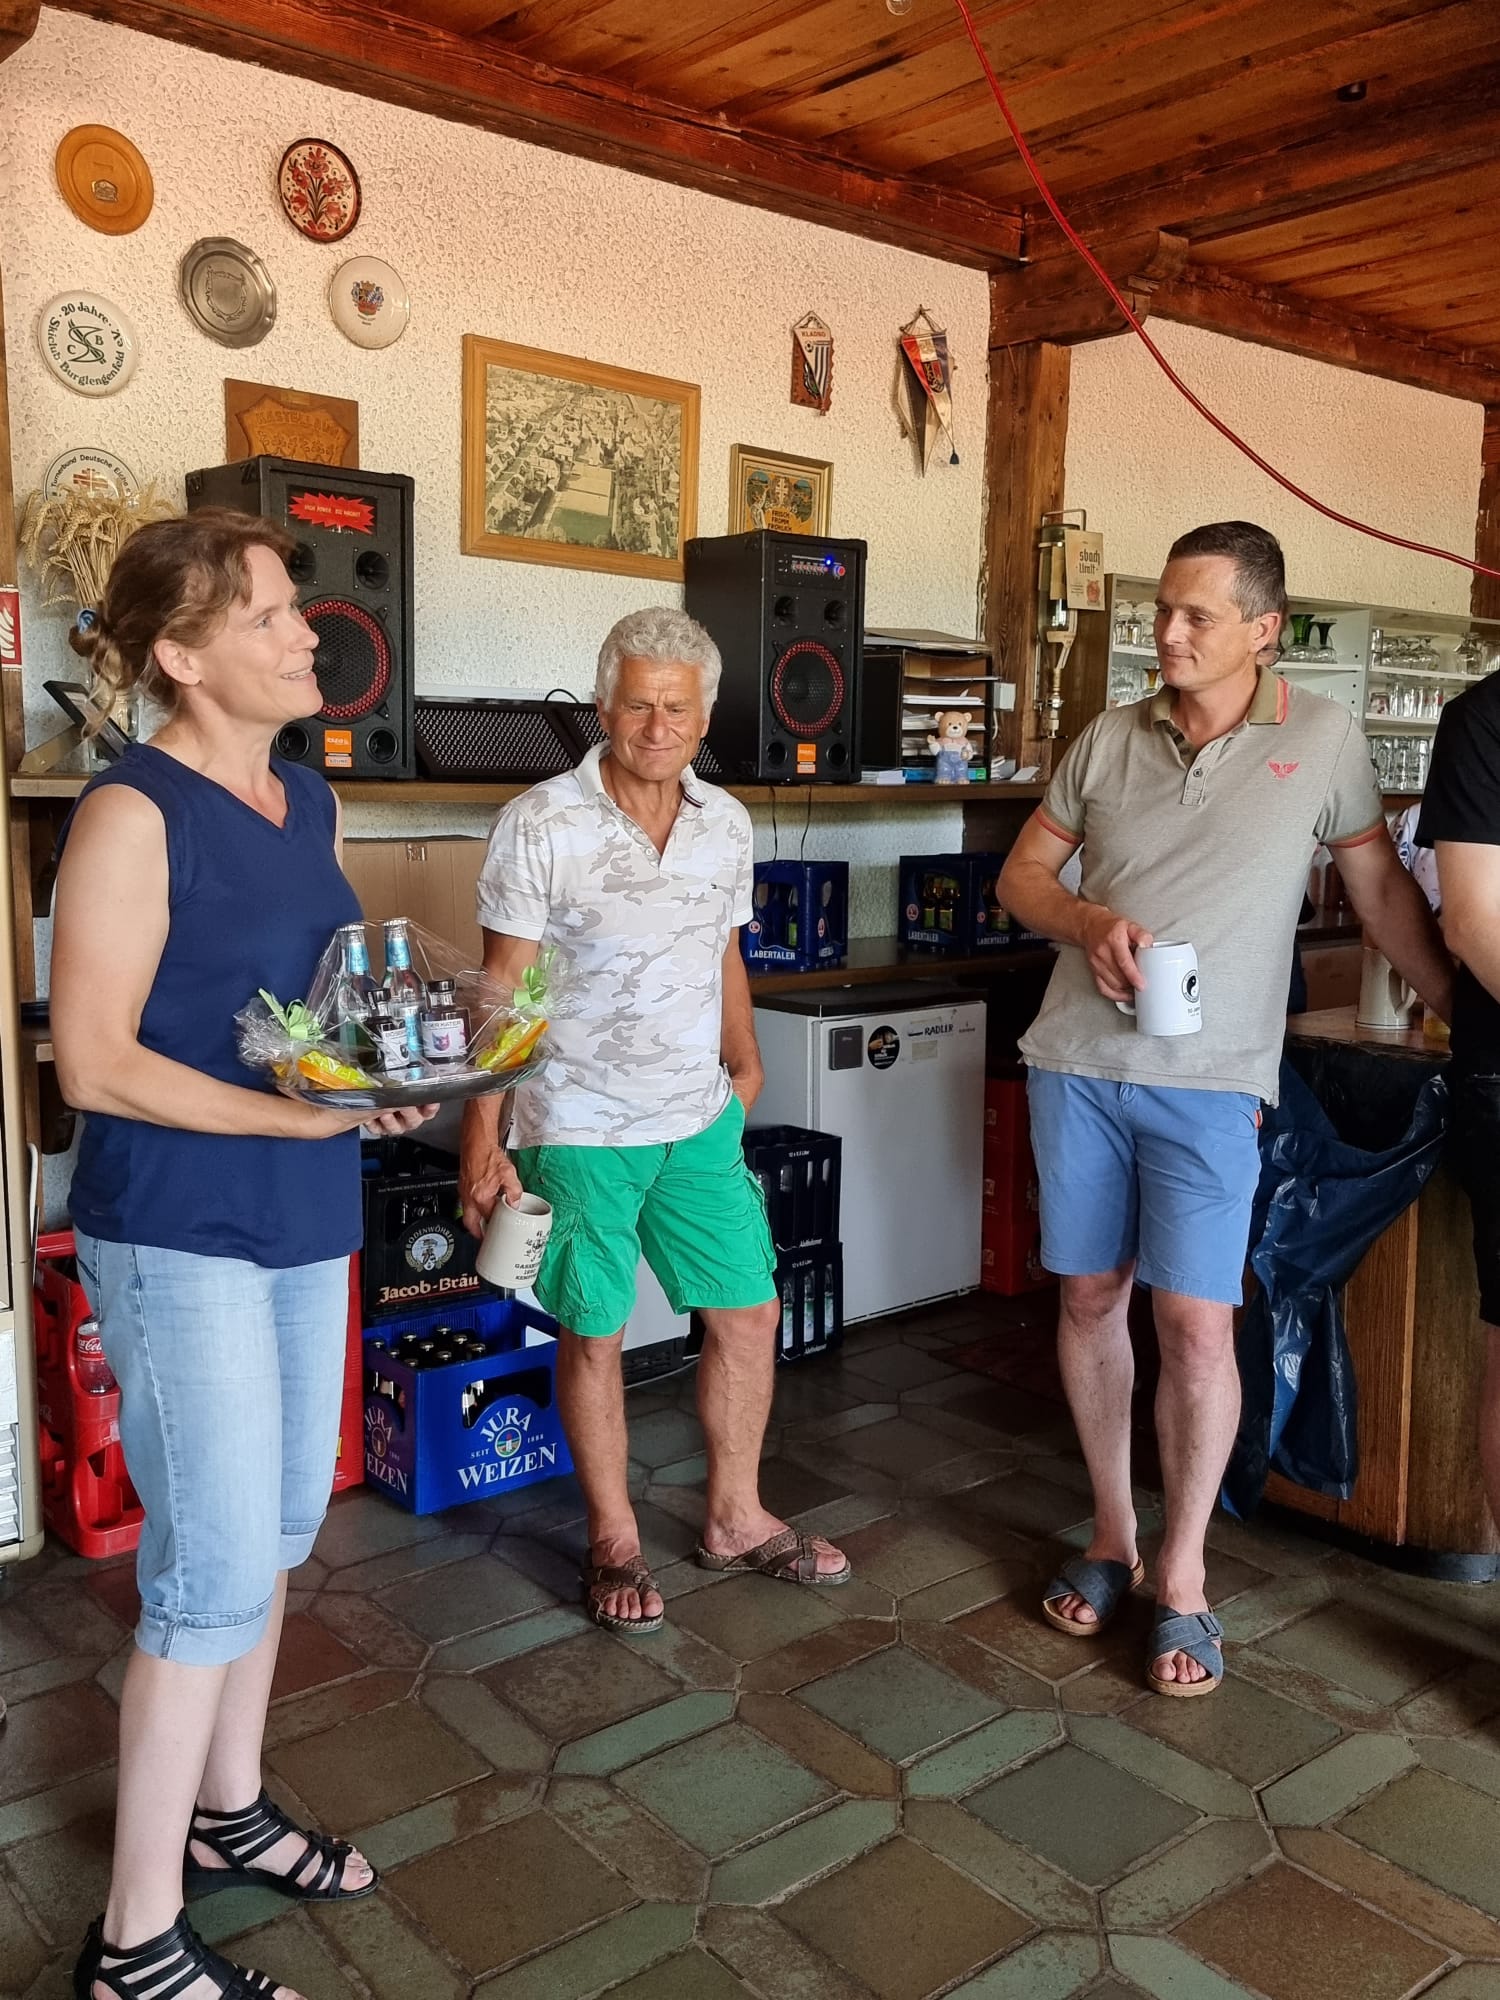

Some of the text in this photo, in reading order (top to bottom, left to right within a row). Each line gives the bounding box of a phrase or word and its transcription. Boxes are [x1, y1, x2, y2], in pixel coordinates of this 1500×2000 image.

[61, 301, 109, 324] 20 Jahre
[47, 316, 61, 361] Skiclub
[60, 351, 125, 386] Burglengenfeld
[51, 456, 77, 488] Turnerbund
[80, 454, 113, 469] Deutsche
[113, 466, 129, 488] Eiche
[908, 930, 939, 943] LABERTALER
[977, 936, 1009, 946] LABERTALER
[750, 949, 796, 960] LABERTALER
[379, 1273, 479, 1303] Jacob-Bräu
[365, 1406, 392, 1442] JURA
[480, 1407, 531, 1442] JURA
[457, 1443, 557, 1490] WEIZEN
[471, 1448, 489, 1458] SEIT
[365, 1448, 408, 1495] EIZEN
